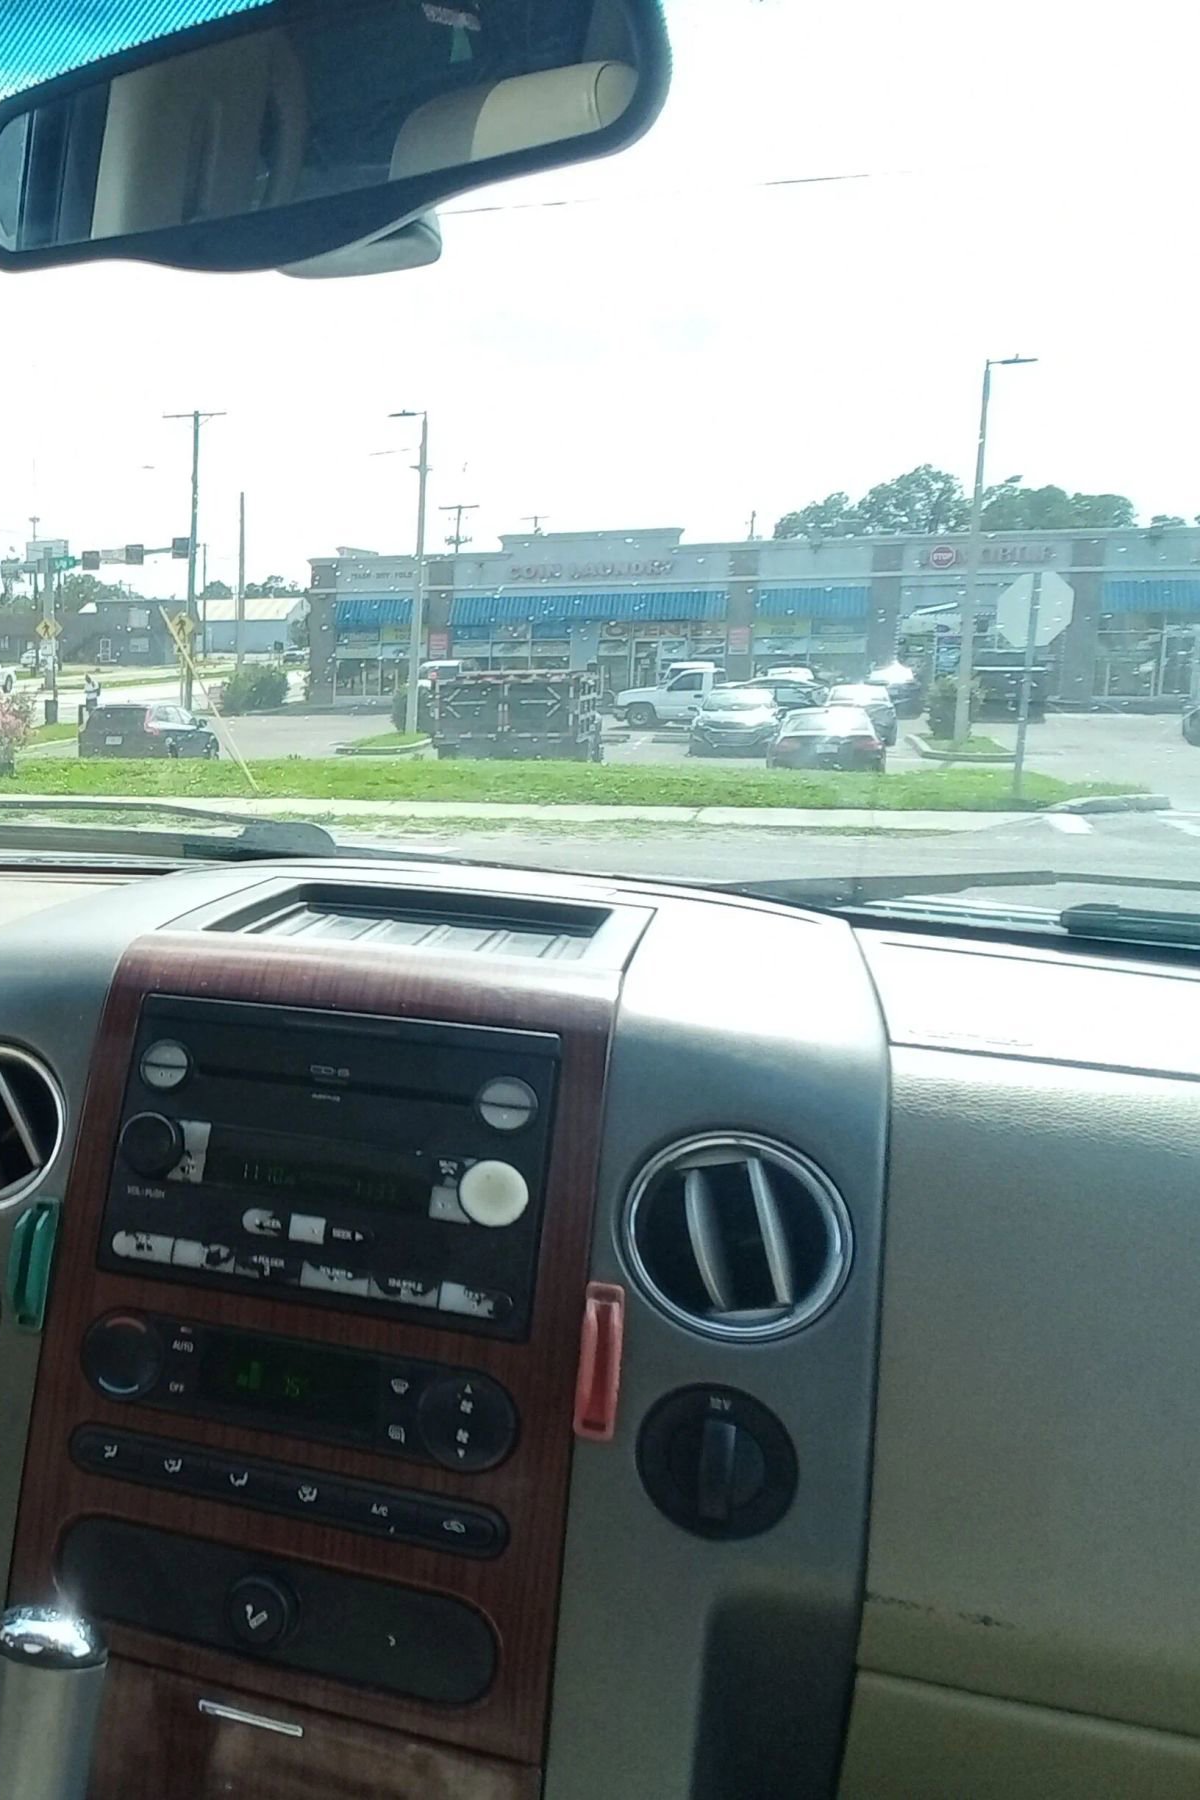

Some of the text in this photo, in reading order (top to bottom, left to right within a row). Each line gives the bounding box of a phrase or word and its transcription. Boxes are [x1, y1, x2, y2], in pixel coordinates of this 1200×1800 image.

[933, 552, 953, 561] STOP
[511, 560, 674, 580] COIN LAUNDRY
[172, 1339, 195, 1353] AUTO
[169, 1380, 185, 1393] OFF
